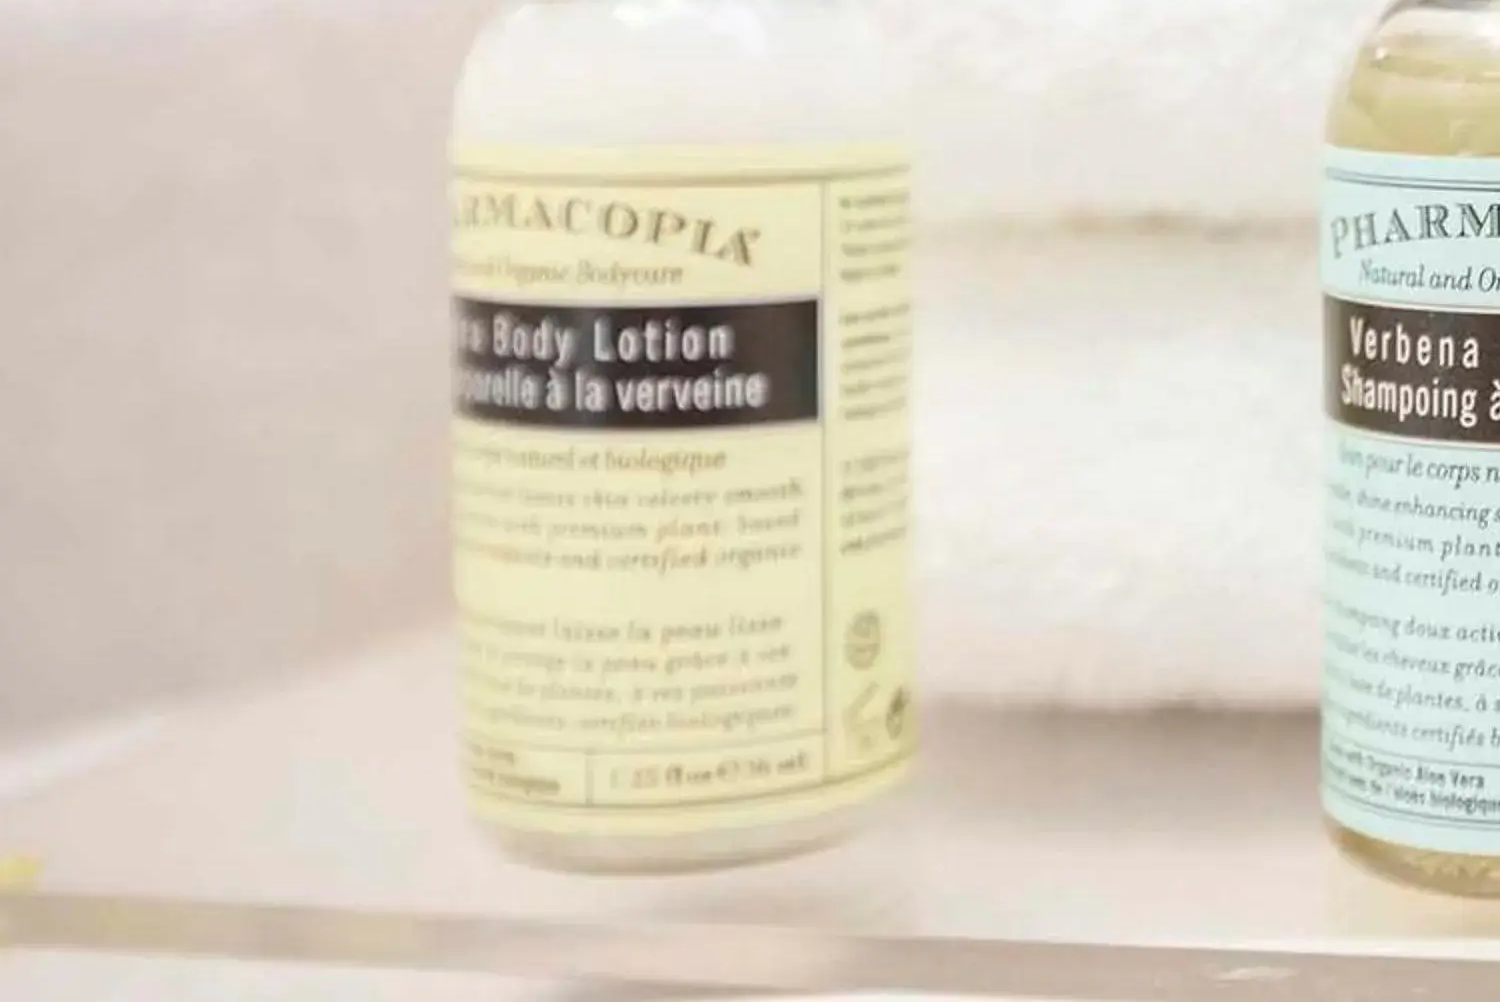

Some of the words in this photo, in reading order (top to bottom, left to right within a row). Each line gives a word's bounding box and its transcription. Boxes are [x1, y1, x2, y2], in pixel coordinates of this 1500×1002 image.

[1358, 260, 1426, 289] Natural
[1430, 269, 1473, 292] and
[493, 313, 574, 366] Body
[594, 317, 736, 363] Lotion
[1349, 317, 1480, 369] Verbena
[545, 366, 564, 410] à
[575, 369, 609, 411] la
[617, 368, 770, 412] verveine
[1340, 362, 1478, 429] Shampoing
[1406, 452, 1424, 478] le
[1426, 462, 1481, 491] corps
[1404, 567, 1482, 597] certified
[1475, 693, 1487, 712] à
